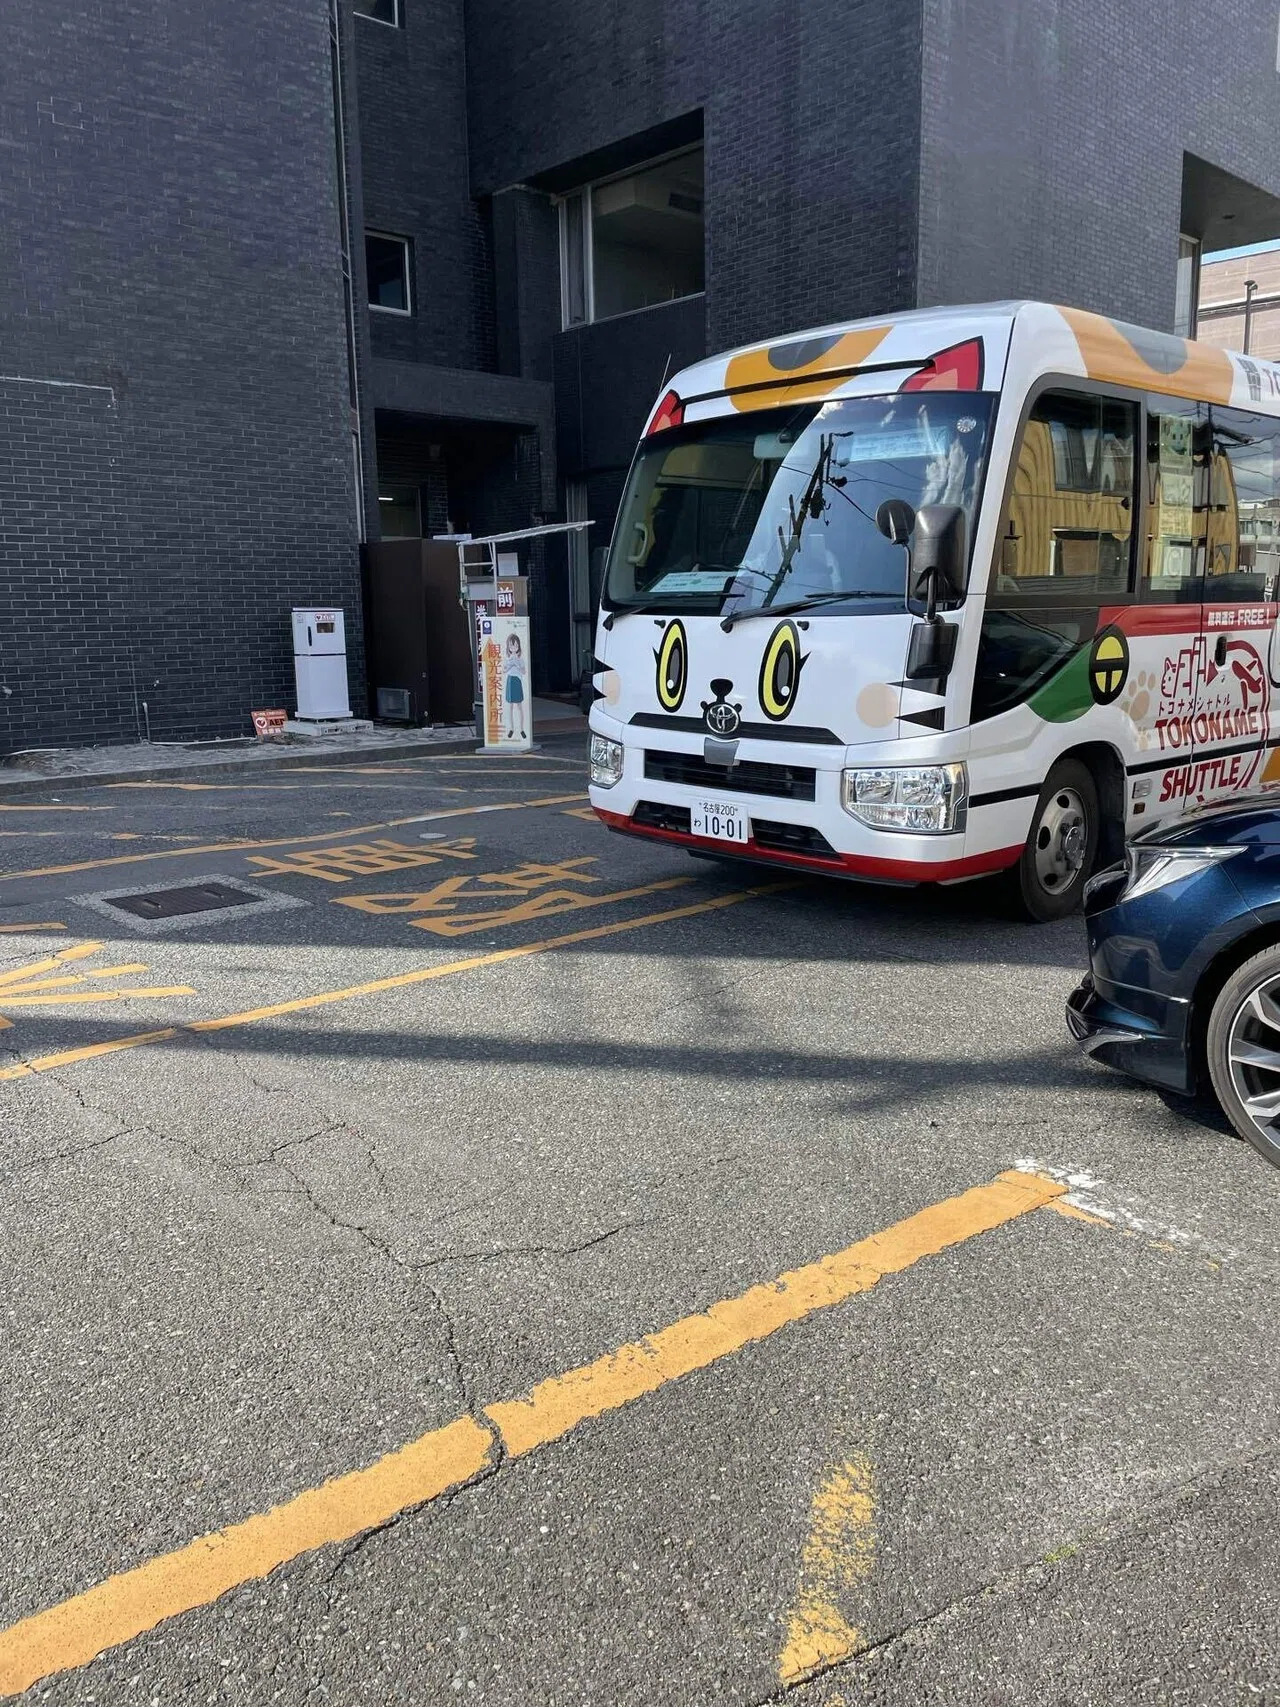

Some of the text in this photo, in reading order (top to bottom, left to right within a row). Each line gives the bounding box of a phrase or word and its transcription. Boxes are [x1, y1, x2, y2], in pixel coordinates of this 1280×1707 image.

[497, 586, 513, 608] 前
[487, 642, 504, 723] 観光案内所
[1154, 705, 1259, 751] TOKONAME
[1159, 756, 1242, 802] SHUTTLE
[704, 814, 742, 840] 10-01
